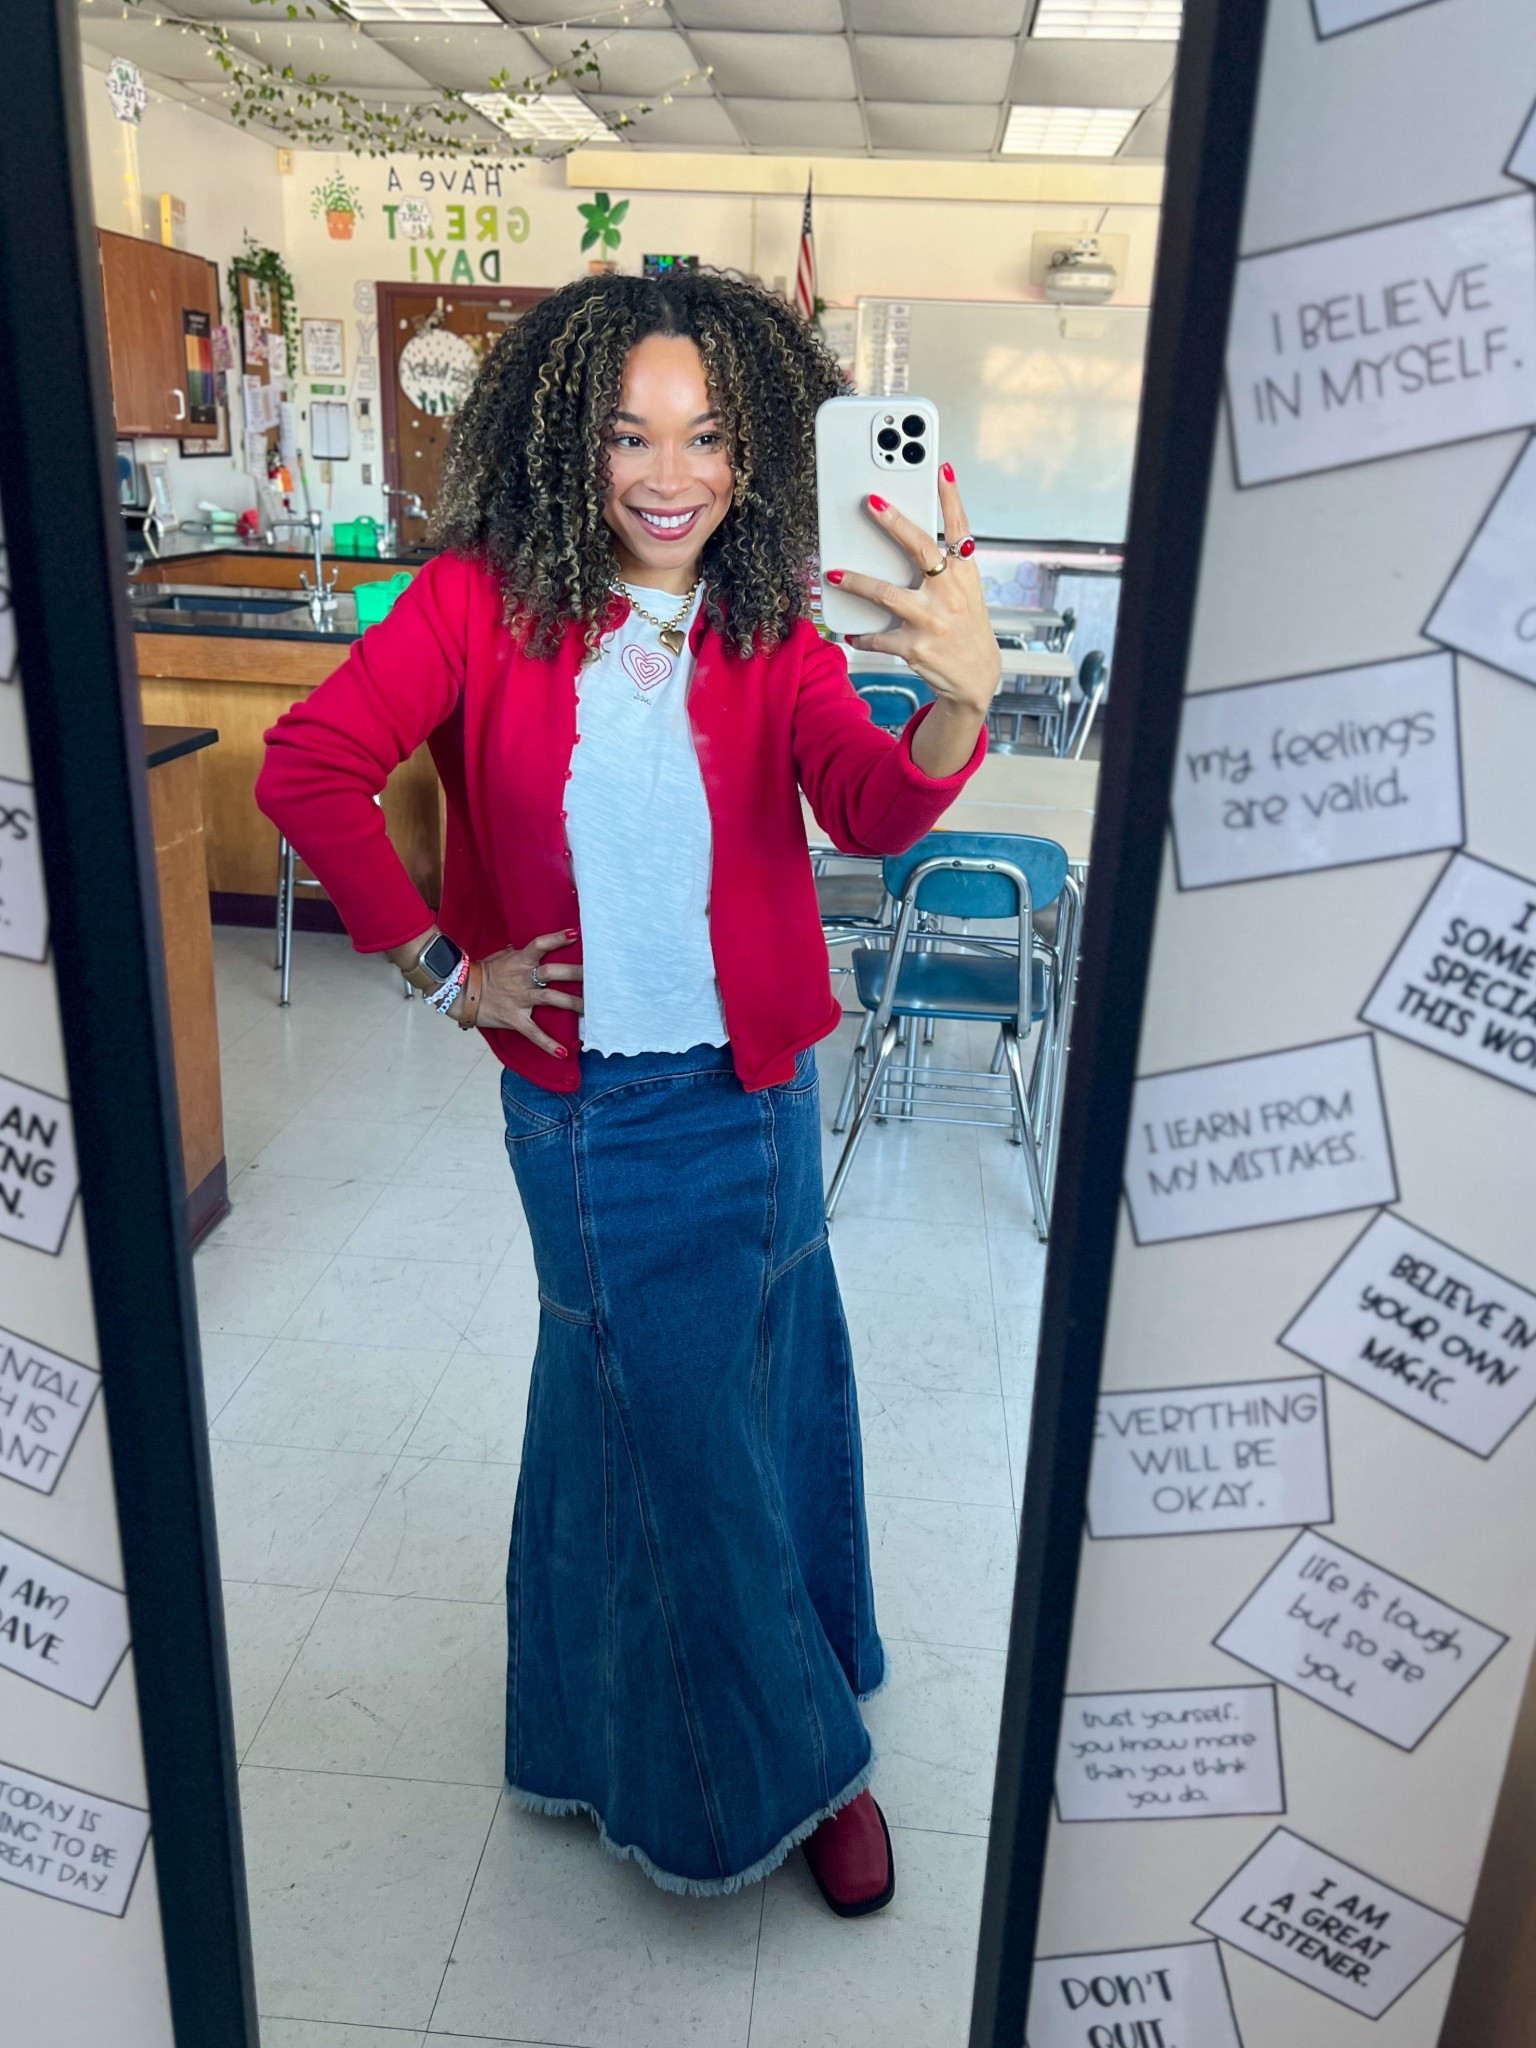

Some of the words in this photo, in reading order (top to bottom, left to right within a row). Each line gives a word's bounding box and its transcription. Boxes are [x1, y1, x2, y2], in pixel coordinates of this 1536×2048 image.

[1271, 312, 1284, 354] I
[1298, 262, 1492, 351] BELIEVE
[1253, 371, 1302, 424] IN
[1320, 326, 1523, 410] MYSELF.
[1185, 746, 1254, 785] my
[1270, 711, 1436, 769] feelings
[1222, 795, 1288, 829] are
[1301, 766, 1409, 818] valid.
[1397, 982, 1476, 1037] THIS
[1481, 1018, 1536, 1071] WO
[1143, 1122, 1157, 1154] I
[1164, 1107, 1252, 1150] LEARN
[1258, 1089, 1354, 1134] FROM
[1147, 1157, 1199, 1196] MY
[1389, 1252, 1507, 1330] BELIEVE
[1501, 1314, 1536, 1351] IN
[1358, 1284, 1440, 1343] YOUR
[1441, 1334, 1521, 1388] OWN
[0, 1343, 81, 1408] NTAL
[1359, 1337, 1456, 1405] MAGIC.
[23, 1400, 56, 1434] IS
[1130, 1444, 1222, 1476] WILL
[1234, 1438, 1277, 1470] BE
[1152, 1480, 1265, 1514] OKAY.
[1287, 1593, 1340, 1638] but
[1342, 1629, 1378, 1658] so
[1382, 1650, 1425, 1683] are
[1351, 1582, 1380, 1610] is
[1382, 1597, 1463, 1660] tough
[1296, 1653, 1357, 1698] you
[1070, 1738, 1114, 1758] you
[1120, 1735, 1187, 1751] know
[1195, 1732, 1256, 1748] more
[1082, 1708, 1135, 1728] trust
[1142, 1702, 1239, 1728] yourself.
[1085, 1762, 1135, 1781] than
[1142, 1763, 1186, 1782] you
[1193, 1757, 1247, 1776] think
[1127, 1790, 1171, 1808] you
[52, 1831, 86, 1858] TO
[91, 1843, 118, 1868] BE
[78, 1809, 102, 1832] IS
[1270, 1892, 1296, 1914] A
[1301, 1907, 1391, 1961] GREAT
[1309, 1877, 1337, 1901] I
[1334, 1895, 1391, 1931] AM
[1239, 1904, 1372, 1988] LISTENER.
